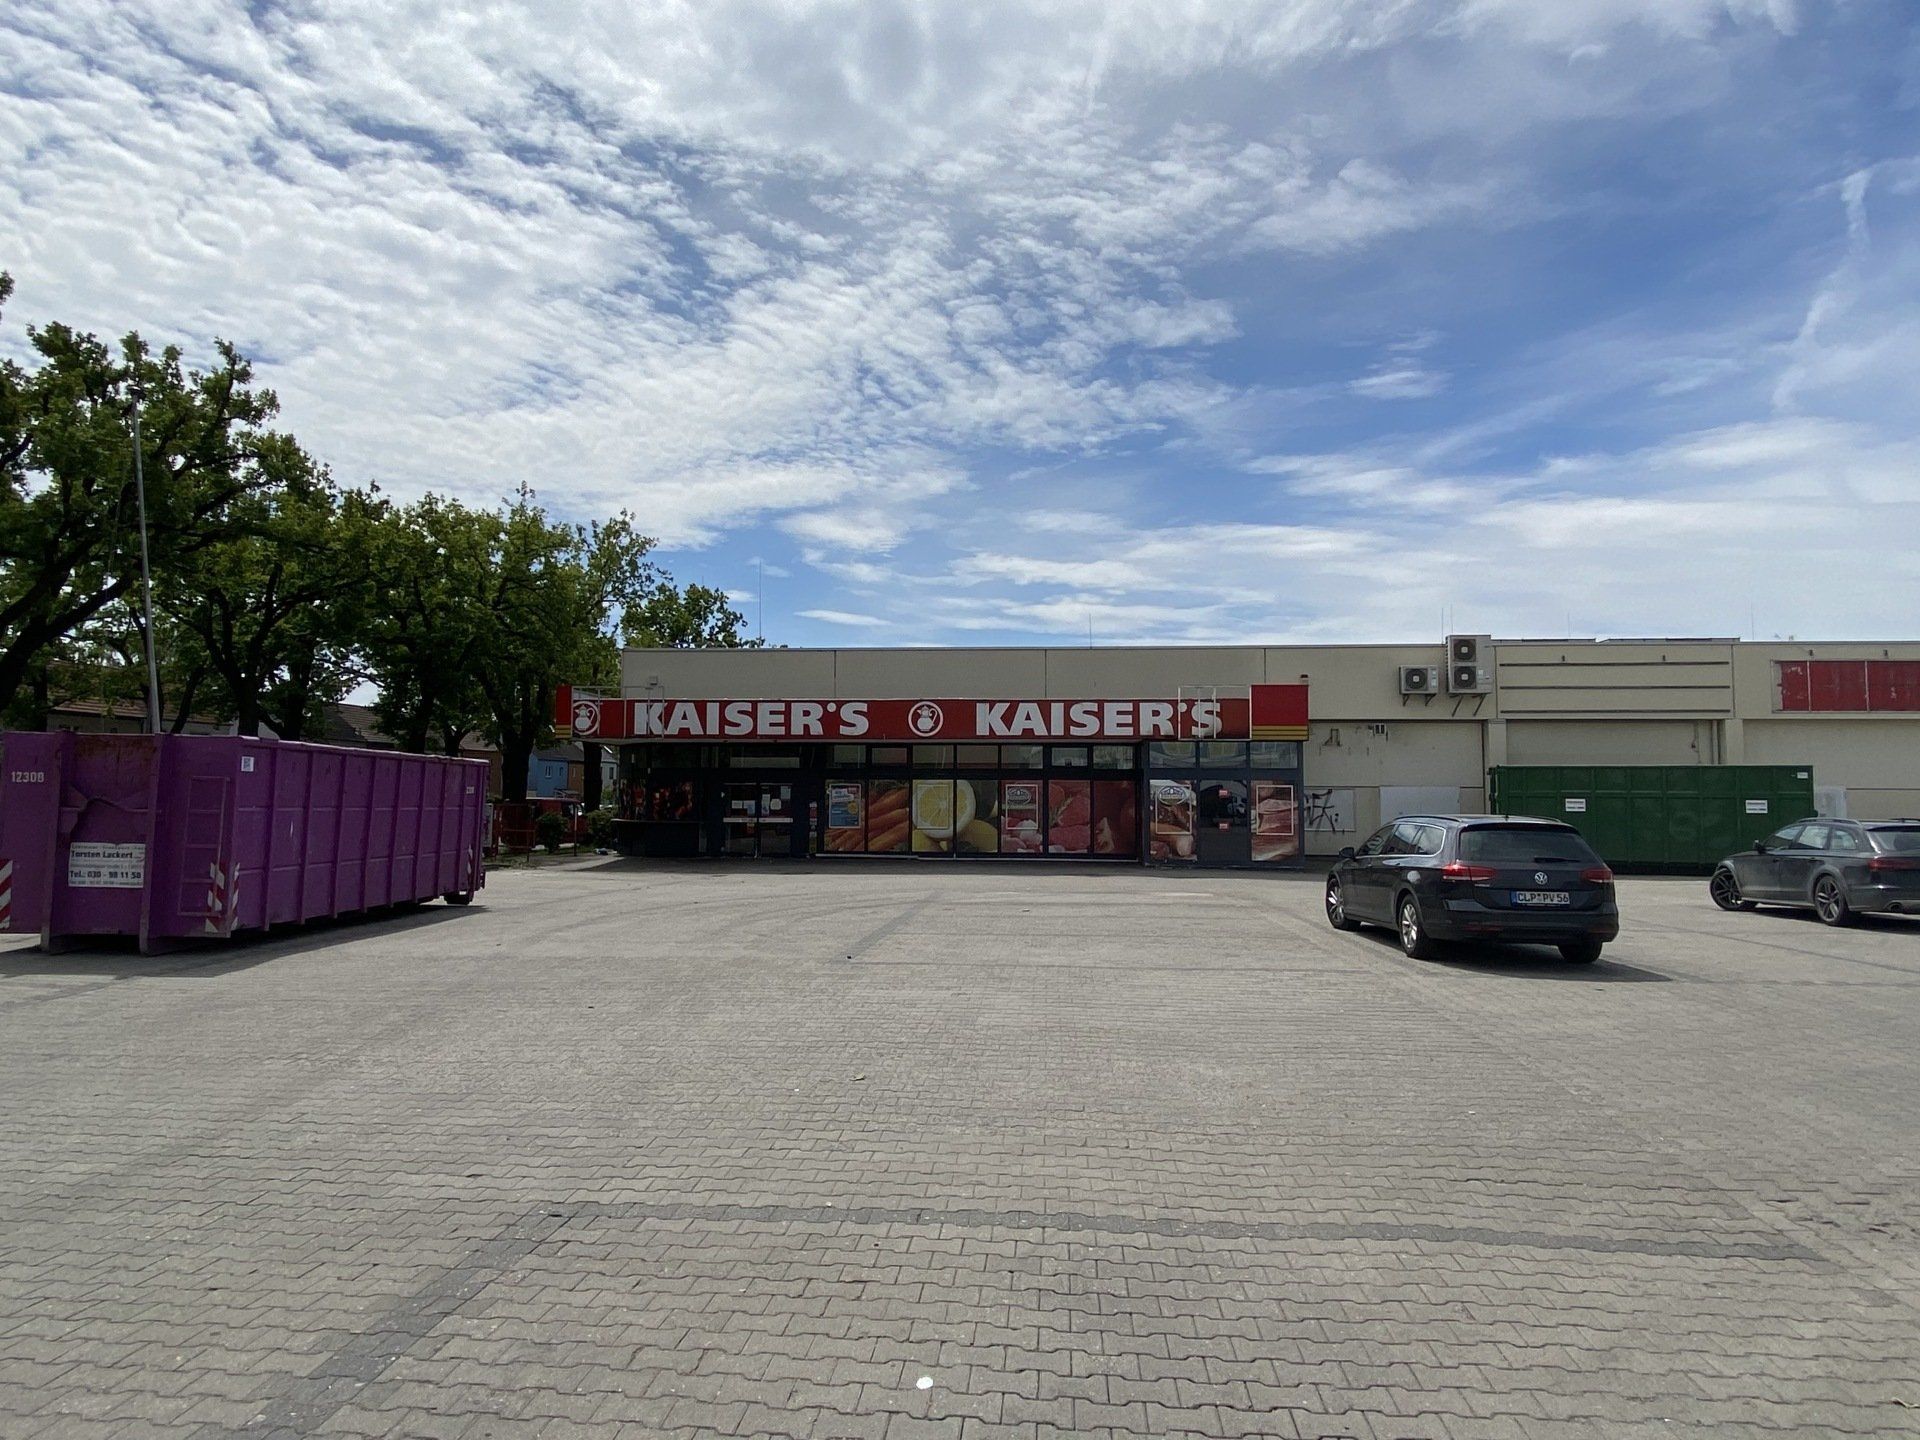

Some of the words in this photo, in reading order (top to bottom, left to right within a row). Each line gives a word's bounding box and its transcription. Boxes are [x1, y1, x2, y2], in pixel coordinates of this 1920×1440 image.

[634, 702, 869, 736] KAISER'S
[976, 702, 1222, 737] KAISER'S
[1518, 892, 1536, 902] CLP
